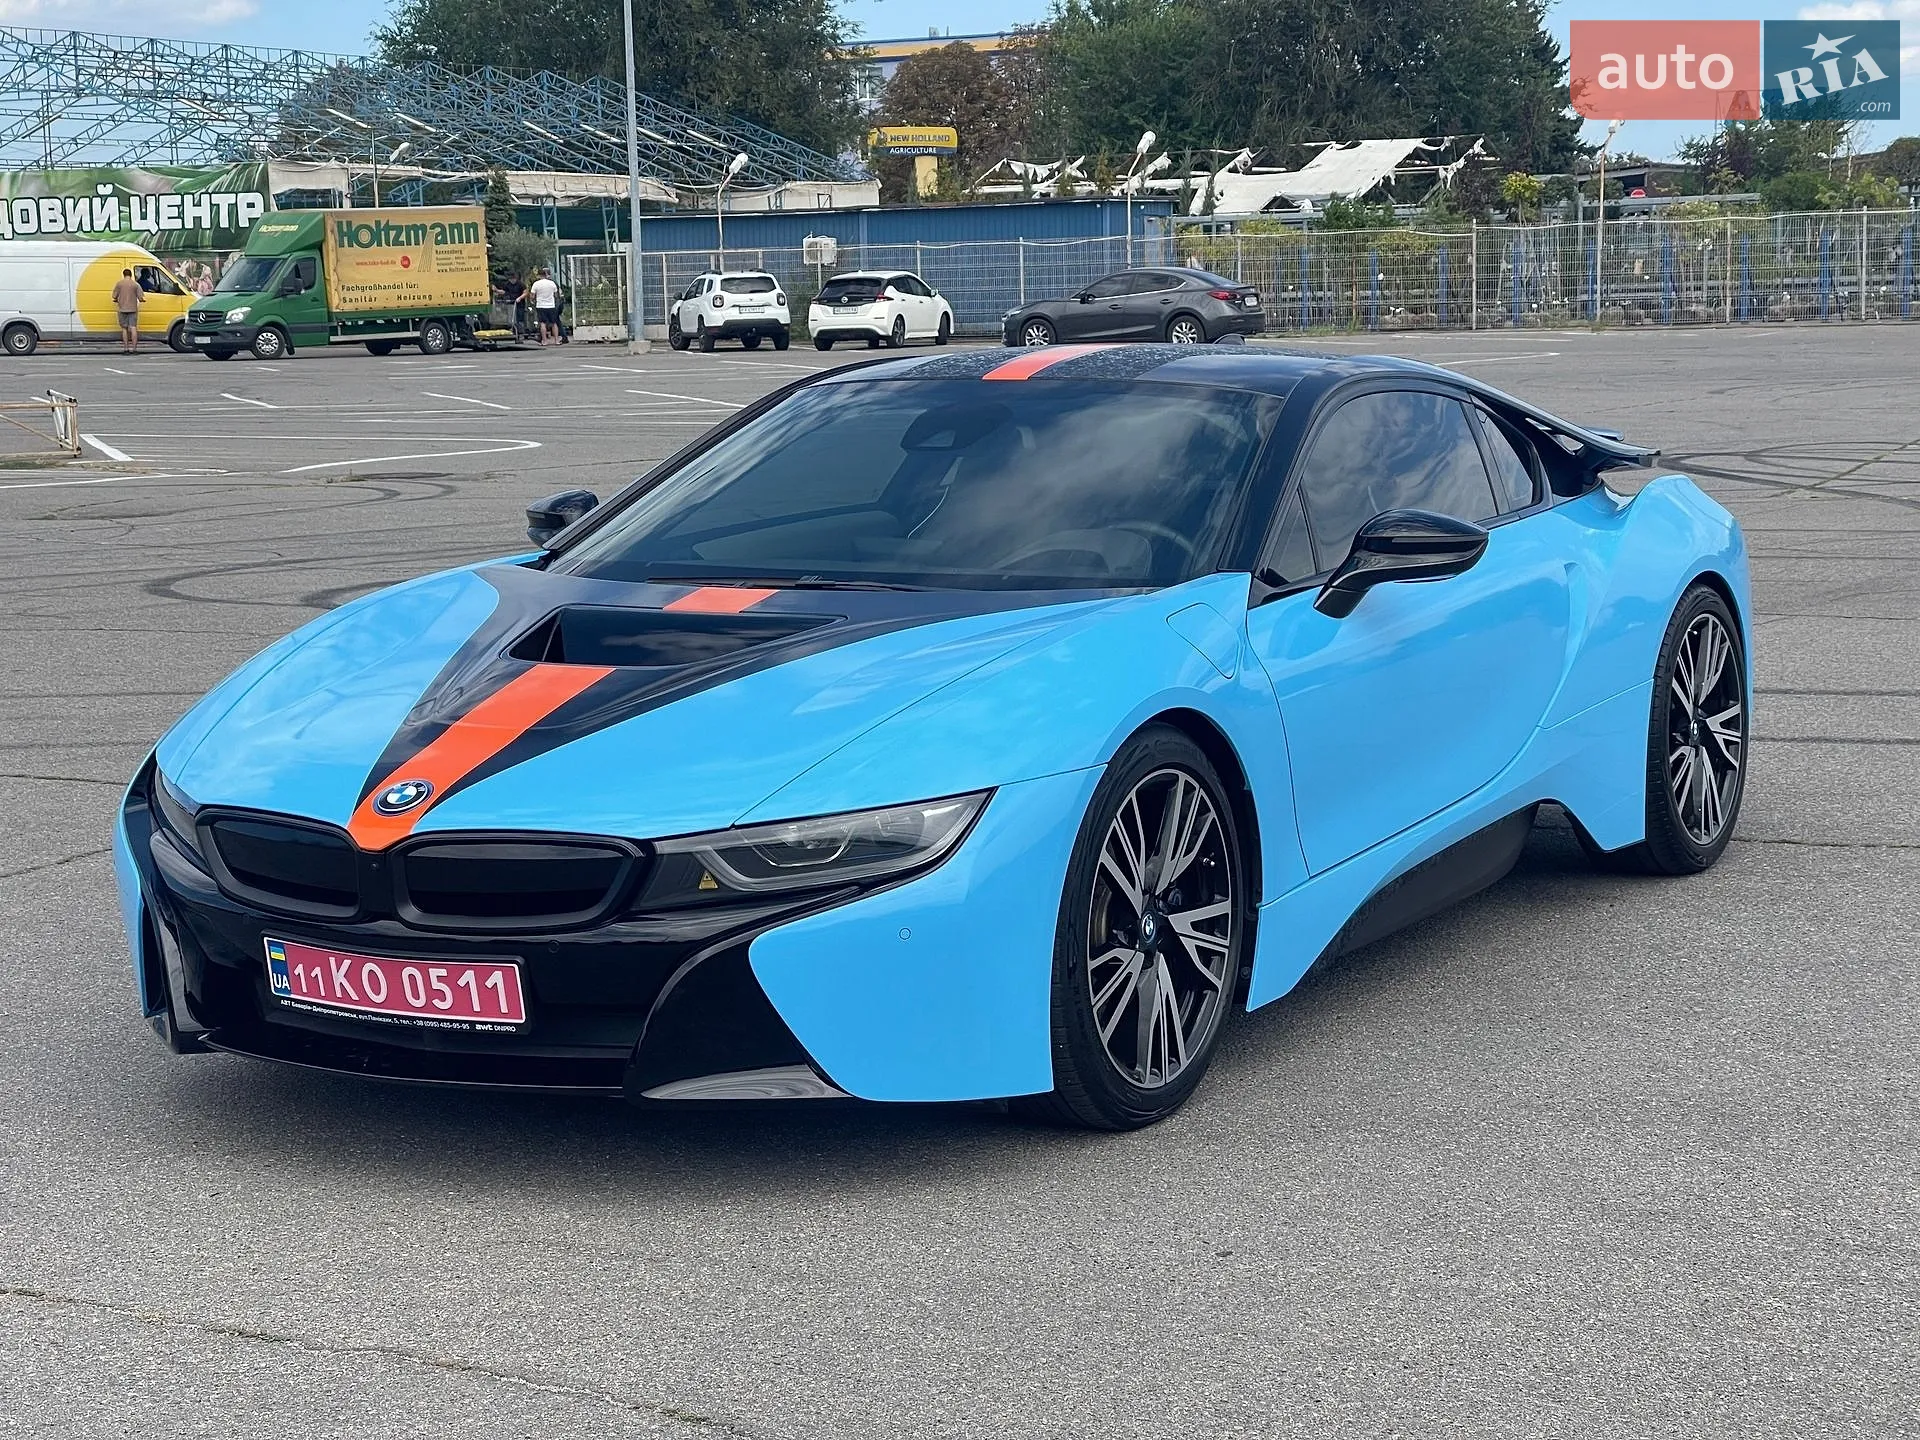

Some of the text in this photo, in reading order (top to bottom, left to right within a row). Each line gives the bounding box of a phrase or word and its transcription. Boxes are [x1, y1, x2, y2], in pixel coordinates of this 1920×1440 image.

[890, 134, 950, 142] NEW HOLLAND
[889, 146, 937, 154] AGRICULTURE
[131, 192, 264, 236] ЦЕНТР
[336, 219, 480, 249] Holtzmann
[341, 282, 404, 293] Fachgroßhandel
[342, 290, 483, 304] Sanitär Heizung Tiefbau
[273, 972, 291, 990] UA
[402, 967, 509, 1014] 0511
[493, 1024, 517, 1032] DNIPRO
